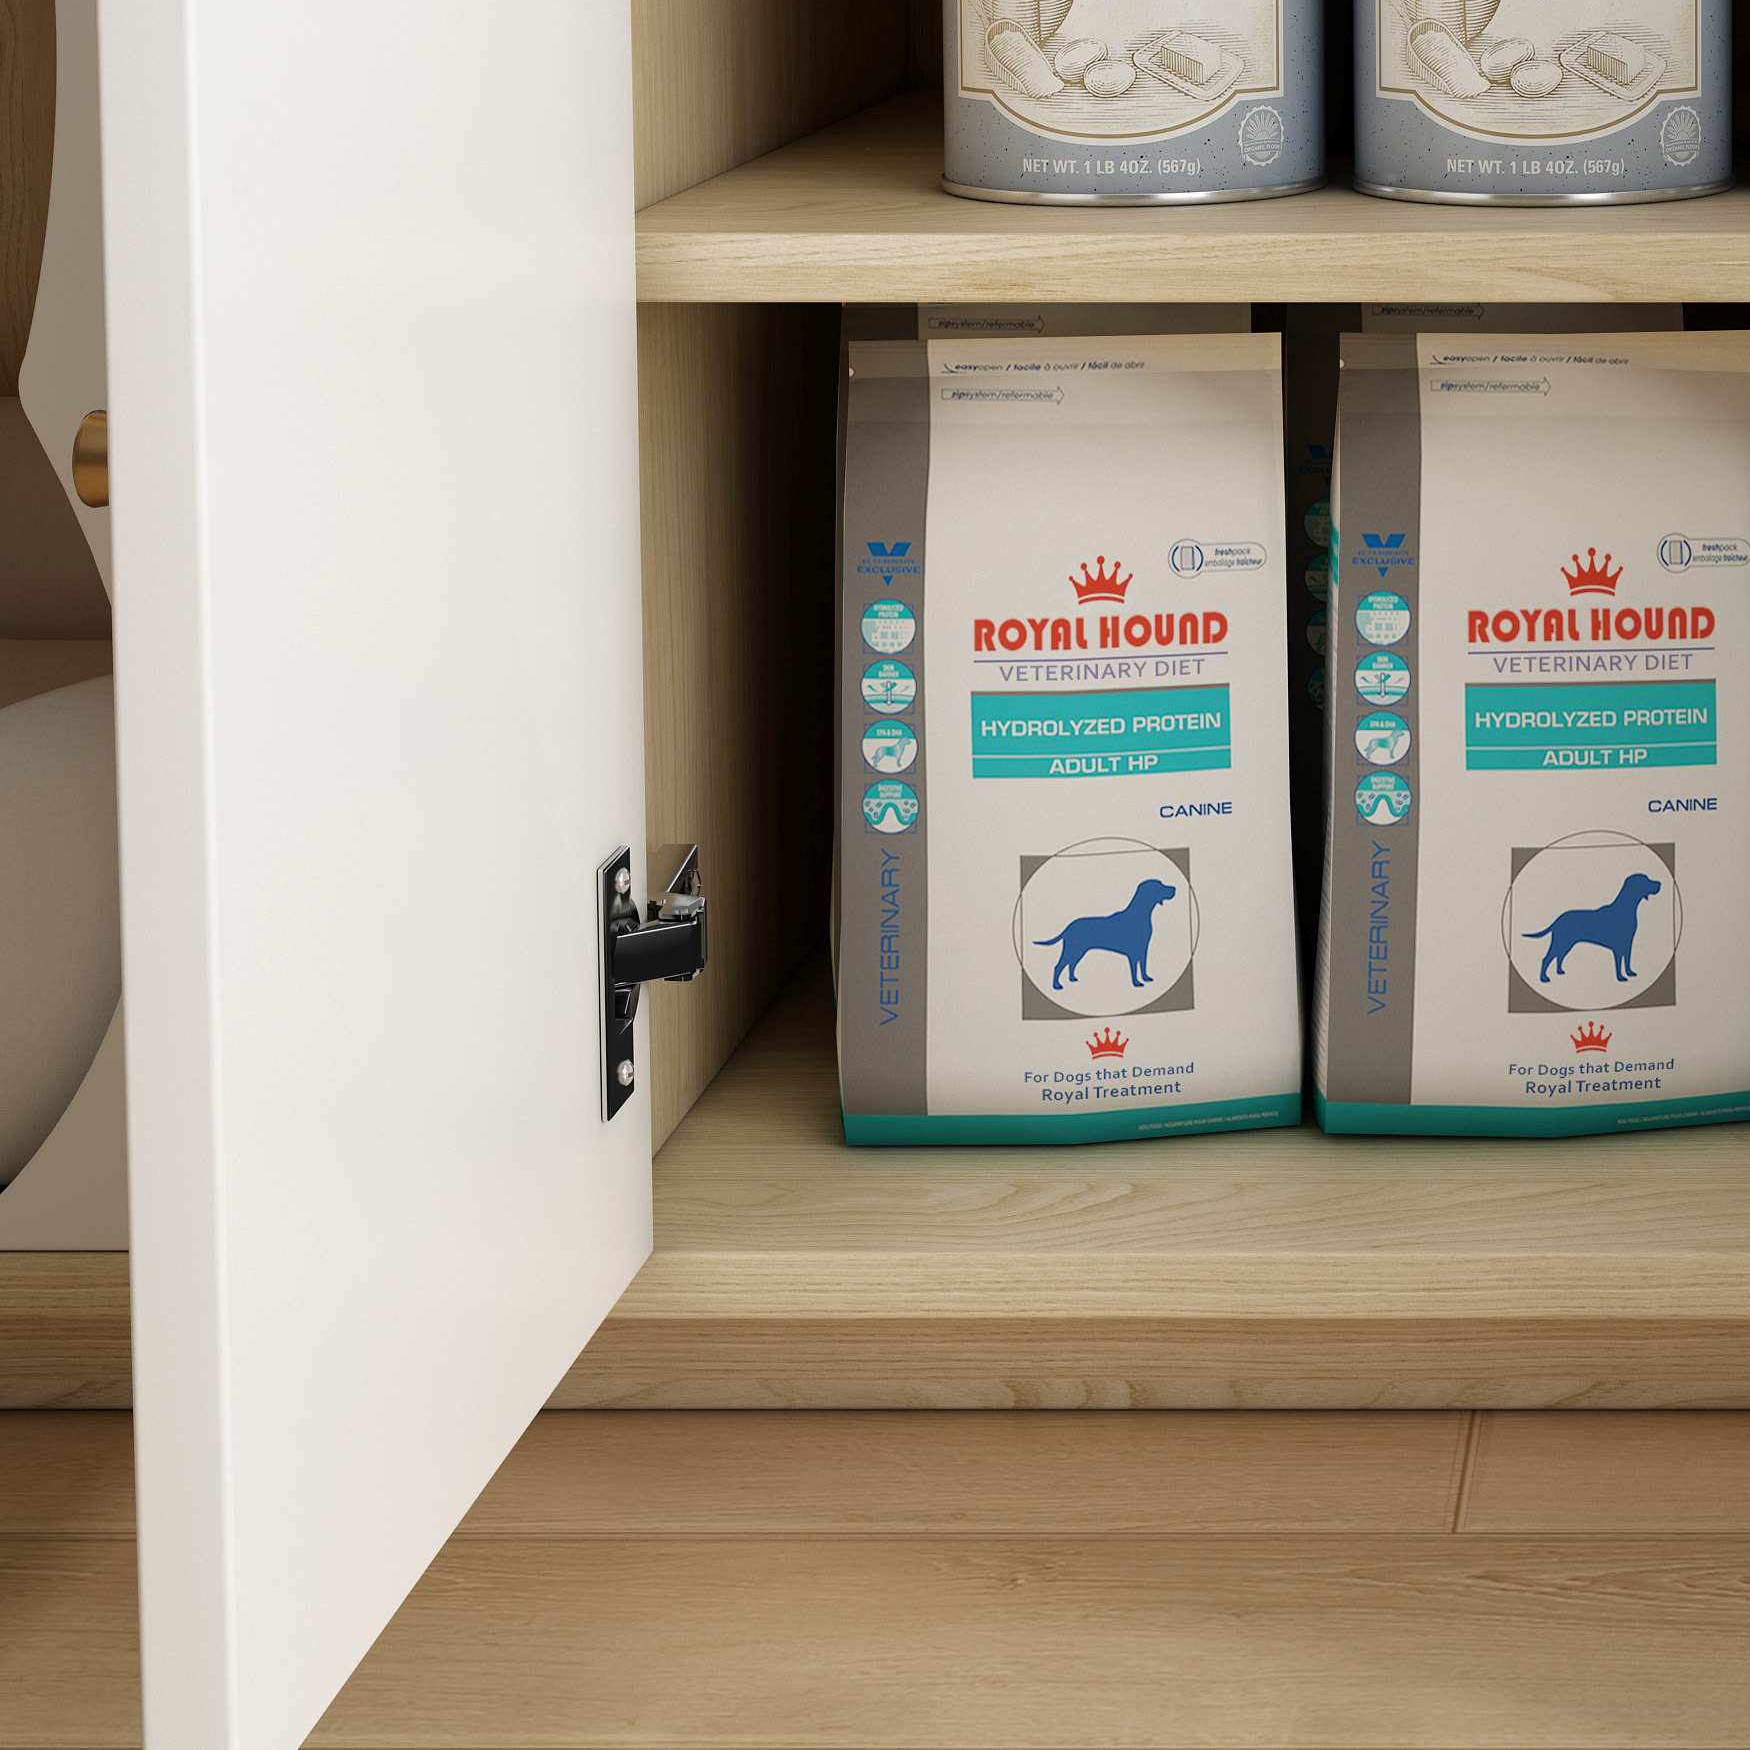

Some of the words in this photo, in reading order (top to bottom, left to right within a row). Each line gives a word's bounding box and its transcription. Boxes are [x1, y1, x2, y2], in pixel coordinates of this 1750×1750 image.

[1023, 158, 1048, 173] NET
[1053, 159, 1079, 174] WT.
[1084, 160, 1090, 174] 1
[1096, 160, 1115, 174] LB
[1158, 158, 1201, 176] (567g)
[1447, 158, 1473, 173] NET
[1478, 159, 1505, 174] WT.
[1510, 160, 1516, 174] 1
[1522, 160, 1541, 174] LB
[1583, 158, 1625, 176] (567g)
[857, 566, 920, 574] EXCLUSIVE
[974, 618, 1088, 651] ROYAL
[1099, 611, 1228, 649] HOUND
[1468, 609, 1580, 642] ROYAL
[1591, 605, 1715, 643] HOUND
[1000, 662, 1147, 682] VETERINARY
[1155, 658, 1205, 677] DIET
[1494, 653, 1637, 674] VETERINARY
[1645, 652, 1693, 672] DIET
[980, 717, 1126, 737] HYDROLYZED
[1132, 712, 1221, 733] PROTEIN
[1474, 708, 1617, 729] HYDROLYZED
[1623, 706, 1708, 728] PROTEIN
[1050, 756, 1120, 775] ADULT
[1128, 755, 1158, 771] HP
[1543, 748, 1611, 768] ADULT
[1618, 748, 1647, 765] HP
[1159, 802, 1232, 818] CANINE
[1647, 797, 1717, 813] CANINE
[880, 849, 900, 1026] VETERINARY
[1368, 841, 1391, 1015] VETERINARY
[1024, 1071, 1048, 1083] For
[1054, 1071, 1091, 1086] Dogs
[1096, 1068, 1128, 1081] that
[1132, 1062, 1194, 1078] Demand
[1509, 1063, 1532, 1076] For
[1538, 1064, 1574, 1079] Dogs
[1579, 1062, 1610, 1075] that
[1614, 1057, 1674, 1074] Demand
[1042, 1087, 1088, 1104] Royal
[1093, 1081, 1181, 1099] Treatment
[1526, 1080, 1571, 1097] Royal
[1575, 1076, 1660, 1094] Treatment
